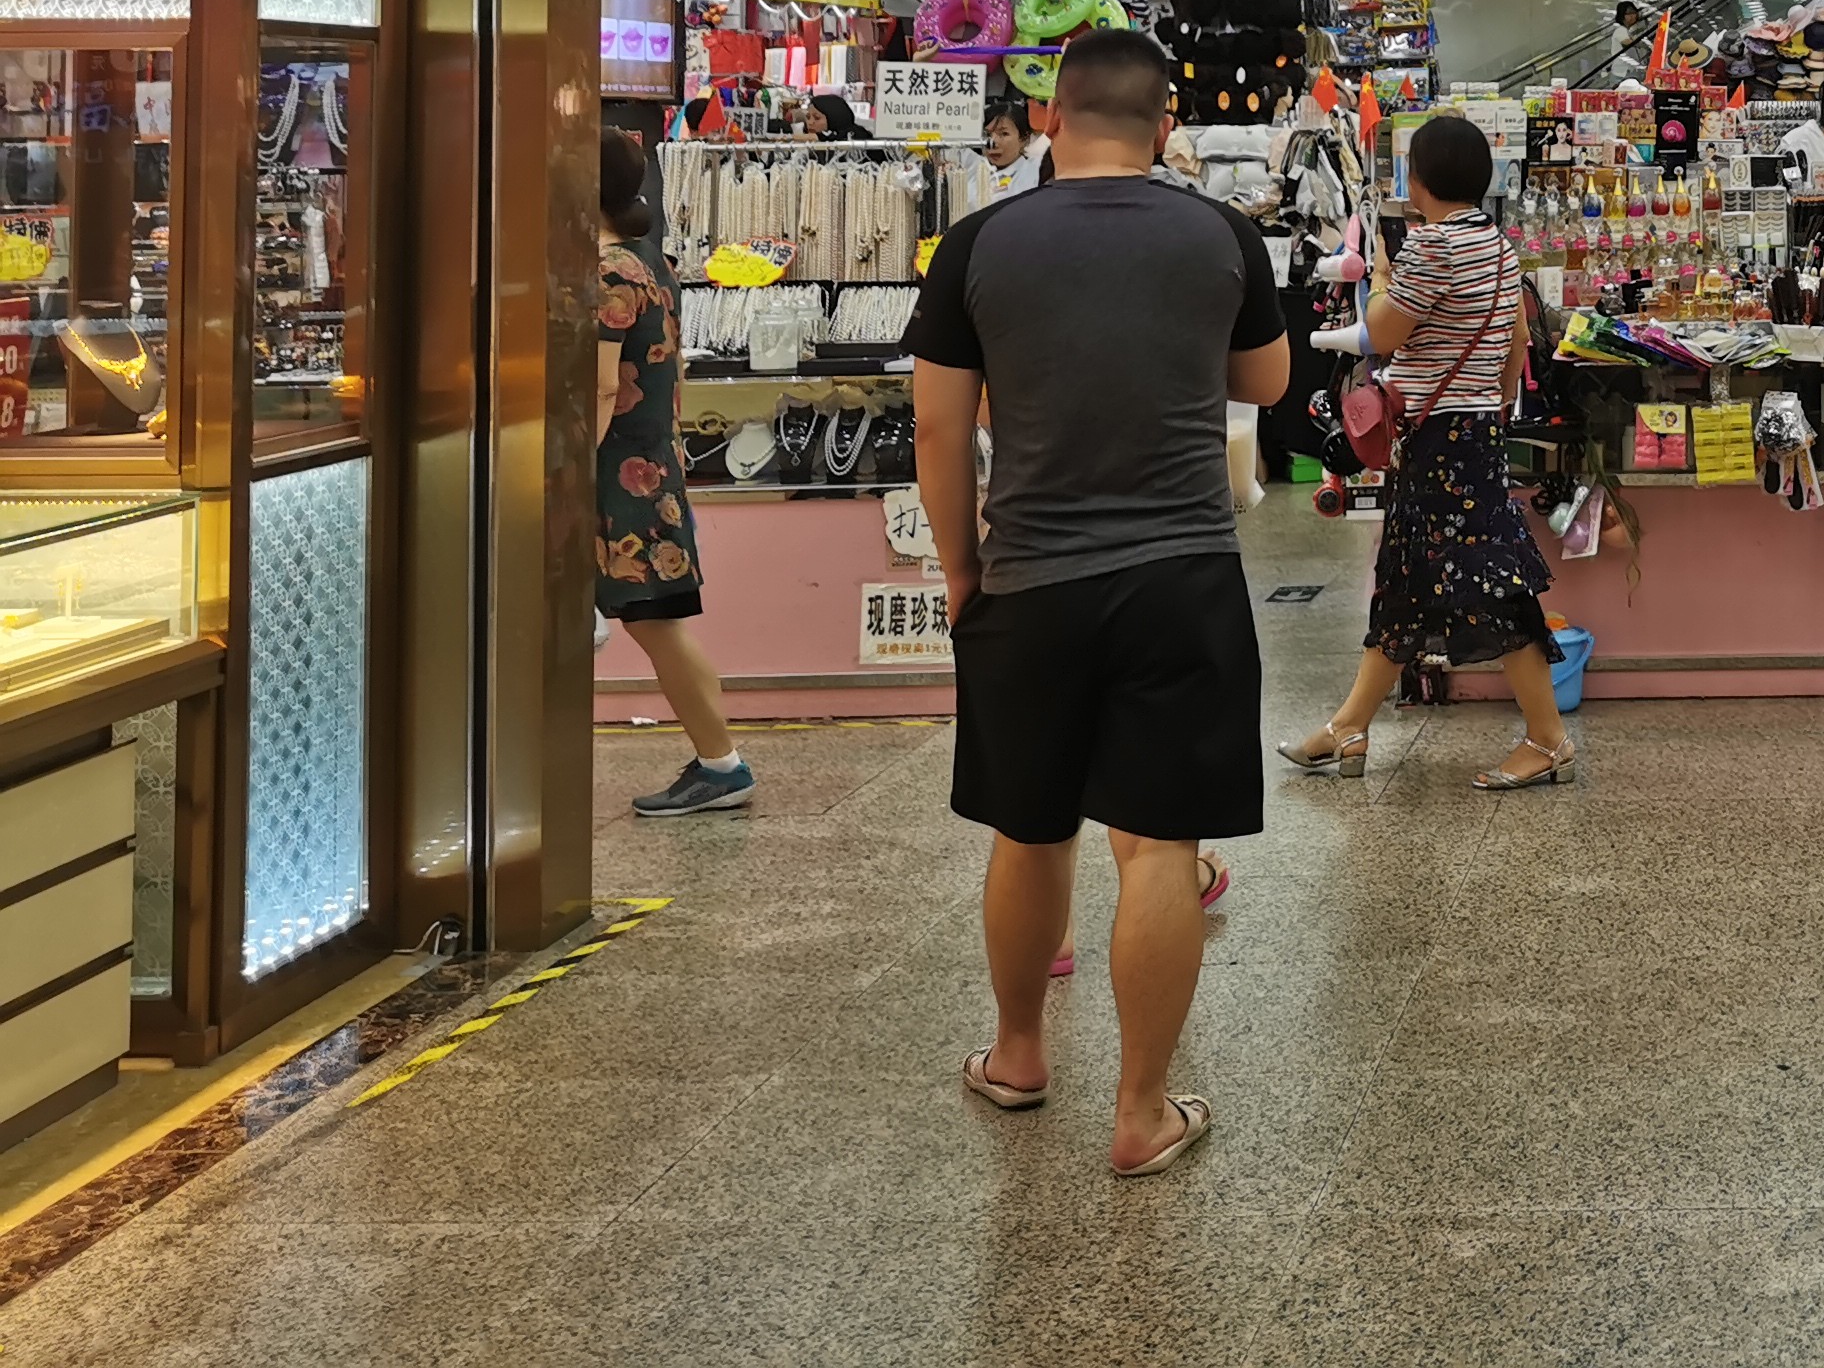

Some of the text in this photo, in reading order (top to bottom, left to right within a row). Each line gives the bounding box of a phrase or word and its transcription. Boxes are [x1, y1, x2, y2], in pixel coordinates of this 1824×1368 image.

[884, 68, 979, 97] 天然珍珠
[883, 101, 970, 117] Natural Pearl
[892, 503, 931, 540] 打
[866, 591, 950, 638] 现磨珍珠
